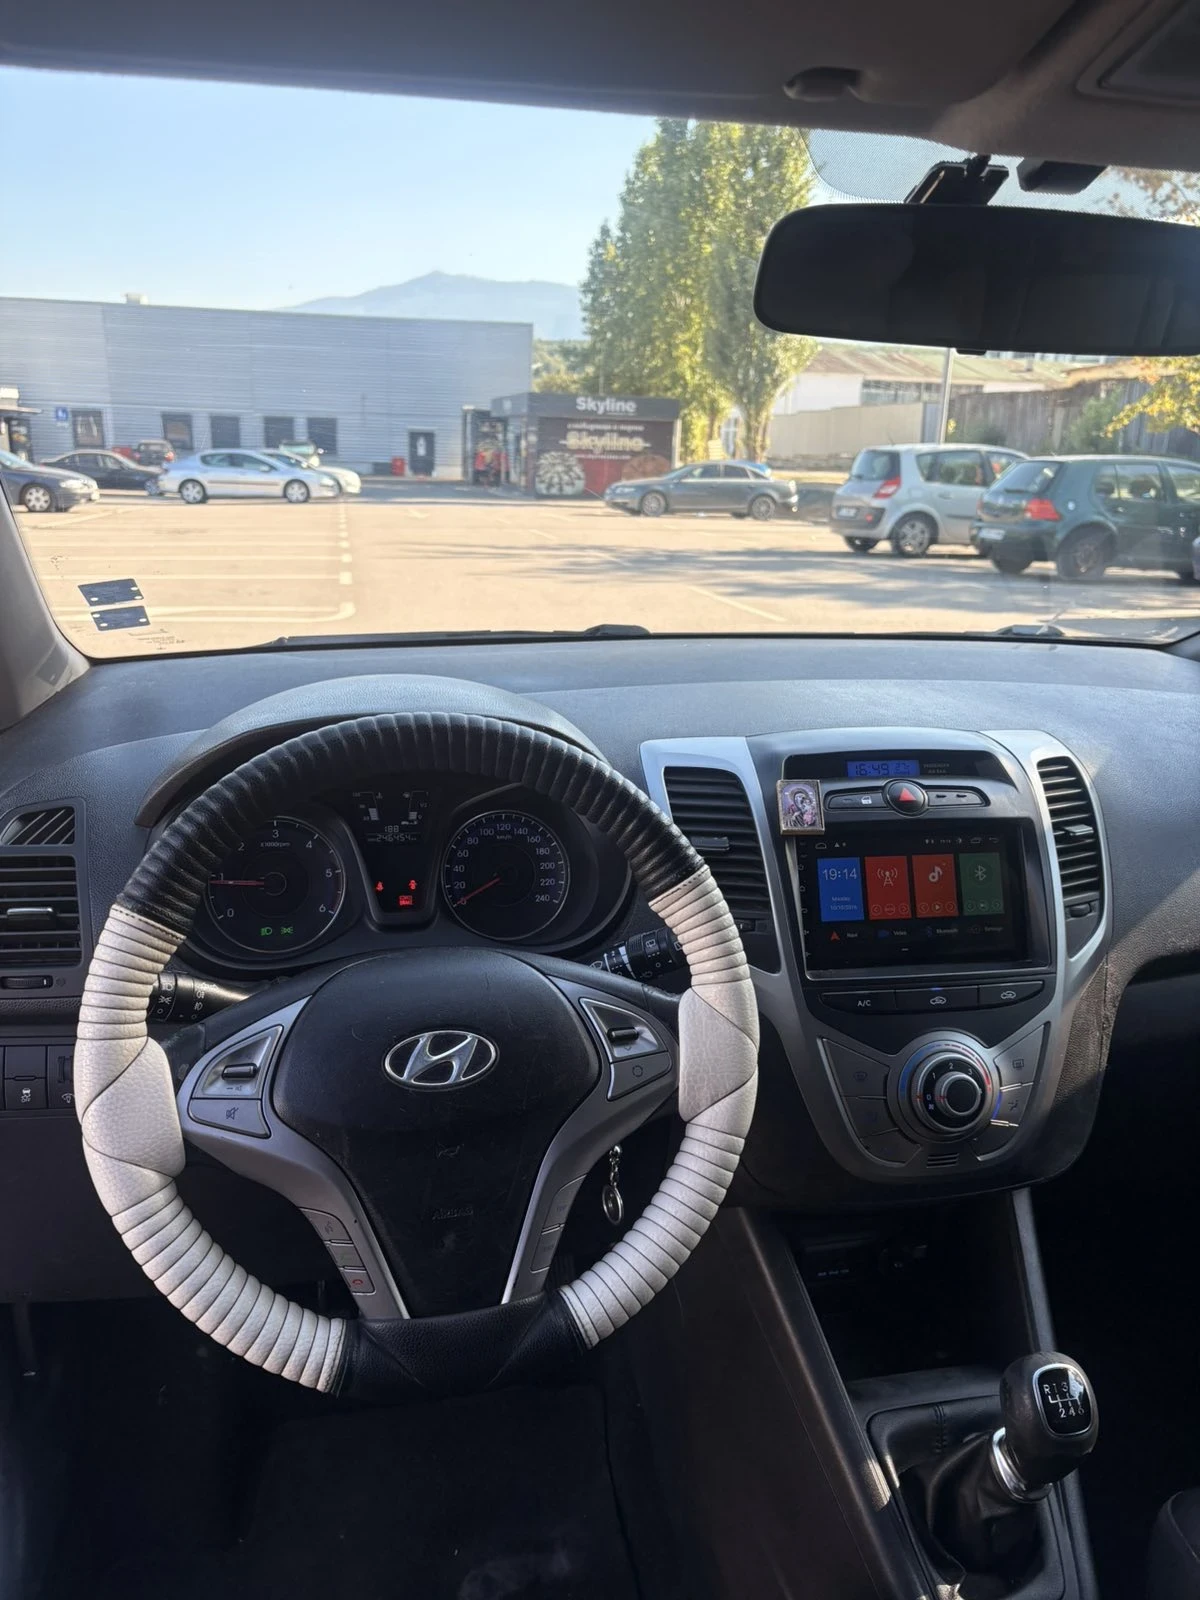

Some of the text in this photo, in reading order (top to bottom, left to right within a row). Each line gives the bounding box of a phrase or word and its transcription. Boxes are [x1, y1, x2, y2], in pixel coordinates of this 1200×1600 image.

[576, 396, 638, 415] Skyline
[855, 763, 890, 776] 16:49
[496, 823, 511, 831] 120
[272, 830, 279, 838] 3
[480, 828, 495, 836] 100
[306, 840, 313, 849] 4
[467, 837, 479, 845] 80
[238, 842, 245, 851] 2
[536, 847, 550, 855] 180
[540, 862, 555, 870] 200
[326, 868, 332, 878] 5
[822, 867, 858, 880] 19:14
[454, 881, 466, 889] 20
[535, 894, 550, 902] 240
[227, 908, 234, 917] 0
[319, 904, 326, 913] 6
[857, 999, 871, 1007] A/C
[948, 1062, 954, 1070] 2
[1043, 1384, 1051, 1394] R
[1061, 1381, 1069, 1392] 3
[1059, 1408, 1067, 1418] 2
[1069, 1406, 1076, 1417] 4
